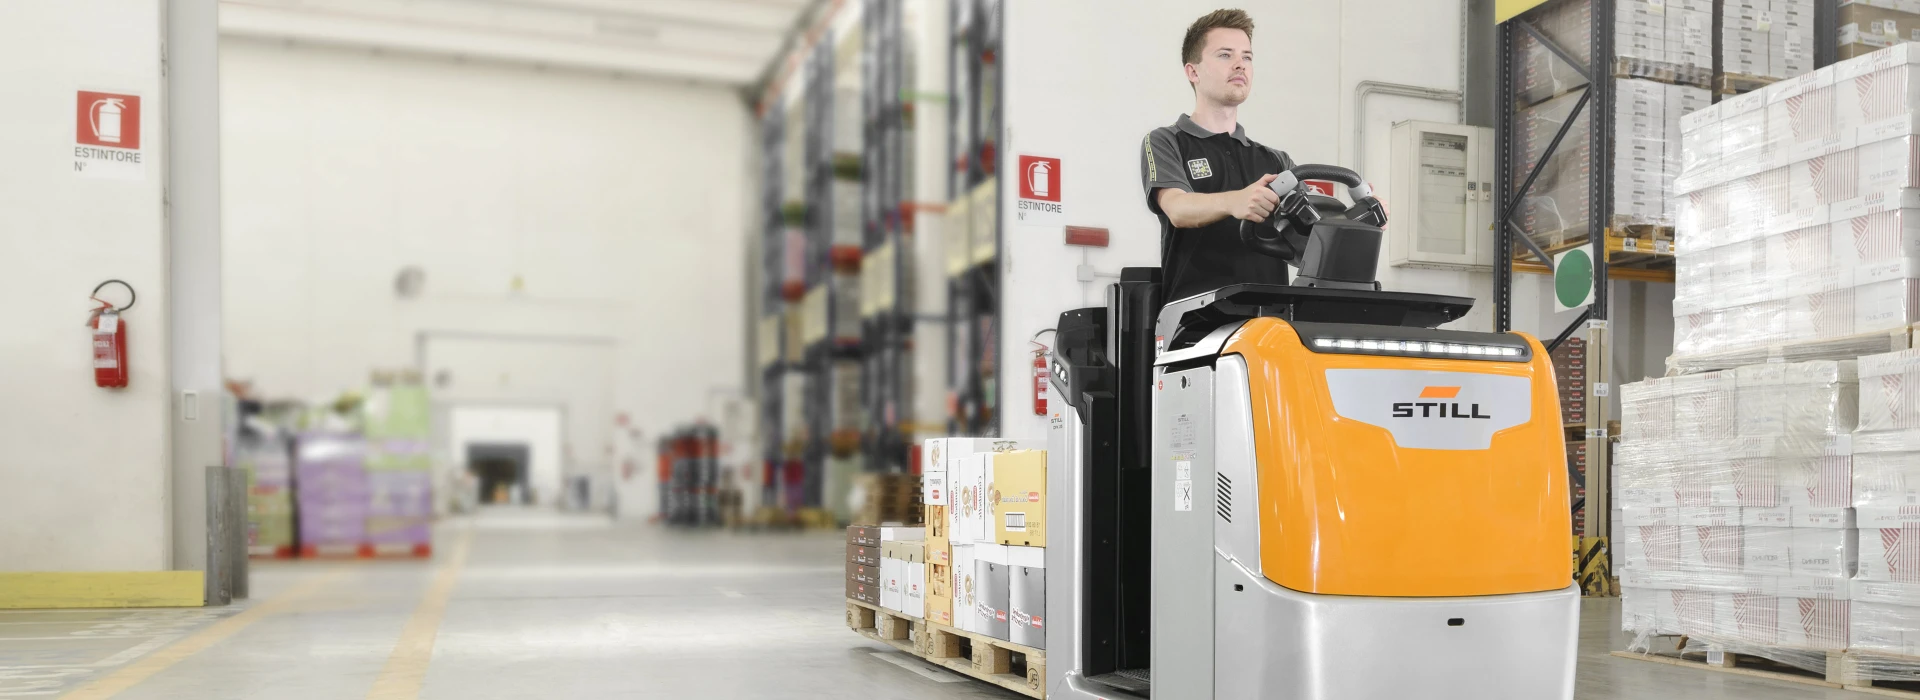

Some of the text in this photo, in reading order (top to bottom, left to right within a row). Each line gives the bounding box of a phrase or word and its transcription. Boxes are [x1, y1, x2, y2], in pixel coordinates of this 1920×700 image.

[74, 146, 141, 164] ESTINTORE
[74, 161, 87, 172] N°
[1018, 200, 1062, 214] ESTINTORE
[1018, 212, 1027, 220] N°
[1392, 402, 1491, 419] STILL
